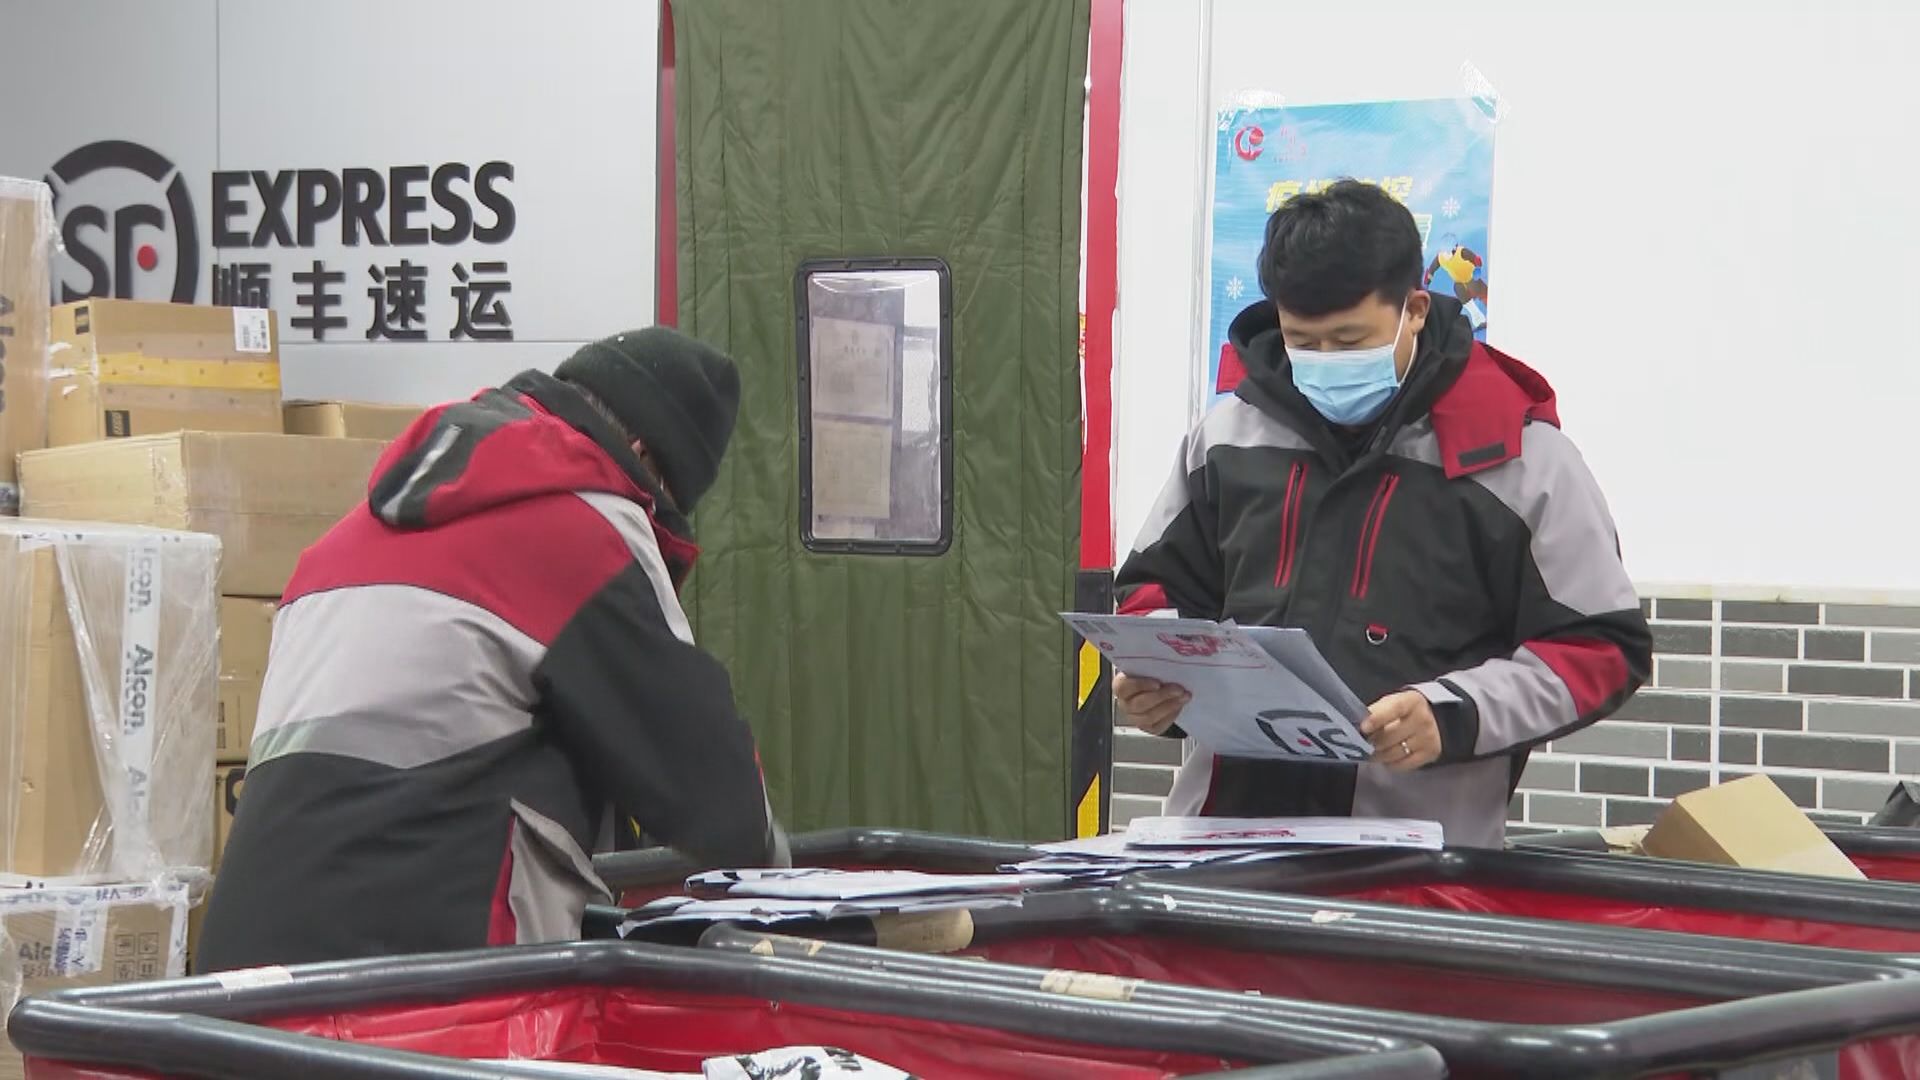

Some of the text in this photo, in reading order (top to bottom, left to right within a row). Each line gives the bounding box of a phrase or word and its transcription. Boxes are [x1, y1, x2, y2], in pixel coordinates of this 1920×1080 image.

[211, 161, 516, 248] EXPRESS
[212, 259, 514, 342] 顺丰速运
[138, 547, 157, 608] lcon
[131, 645, 155, 729] Alcon
[19, 941, 52, 962] Alc
